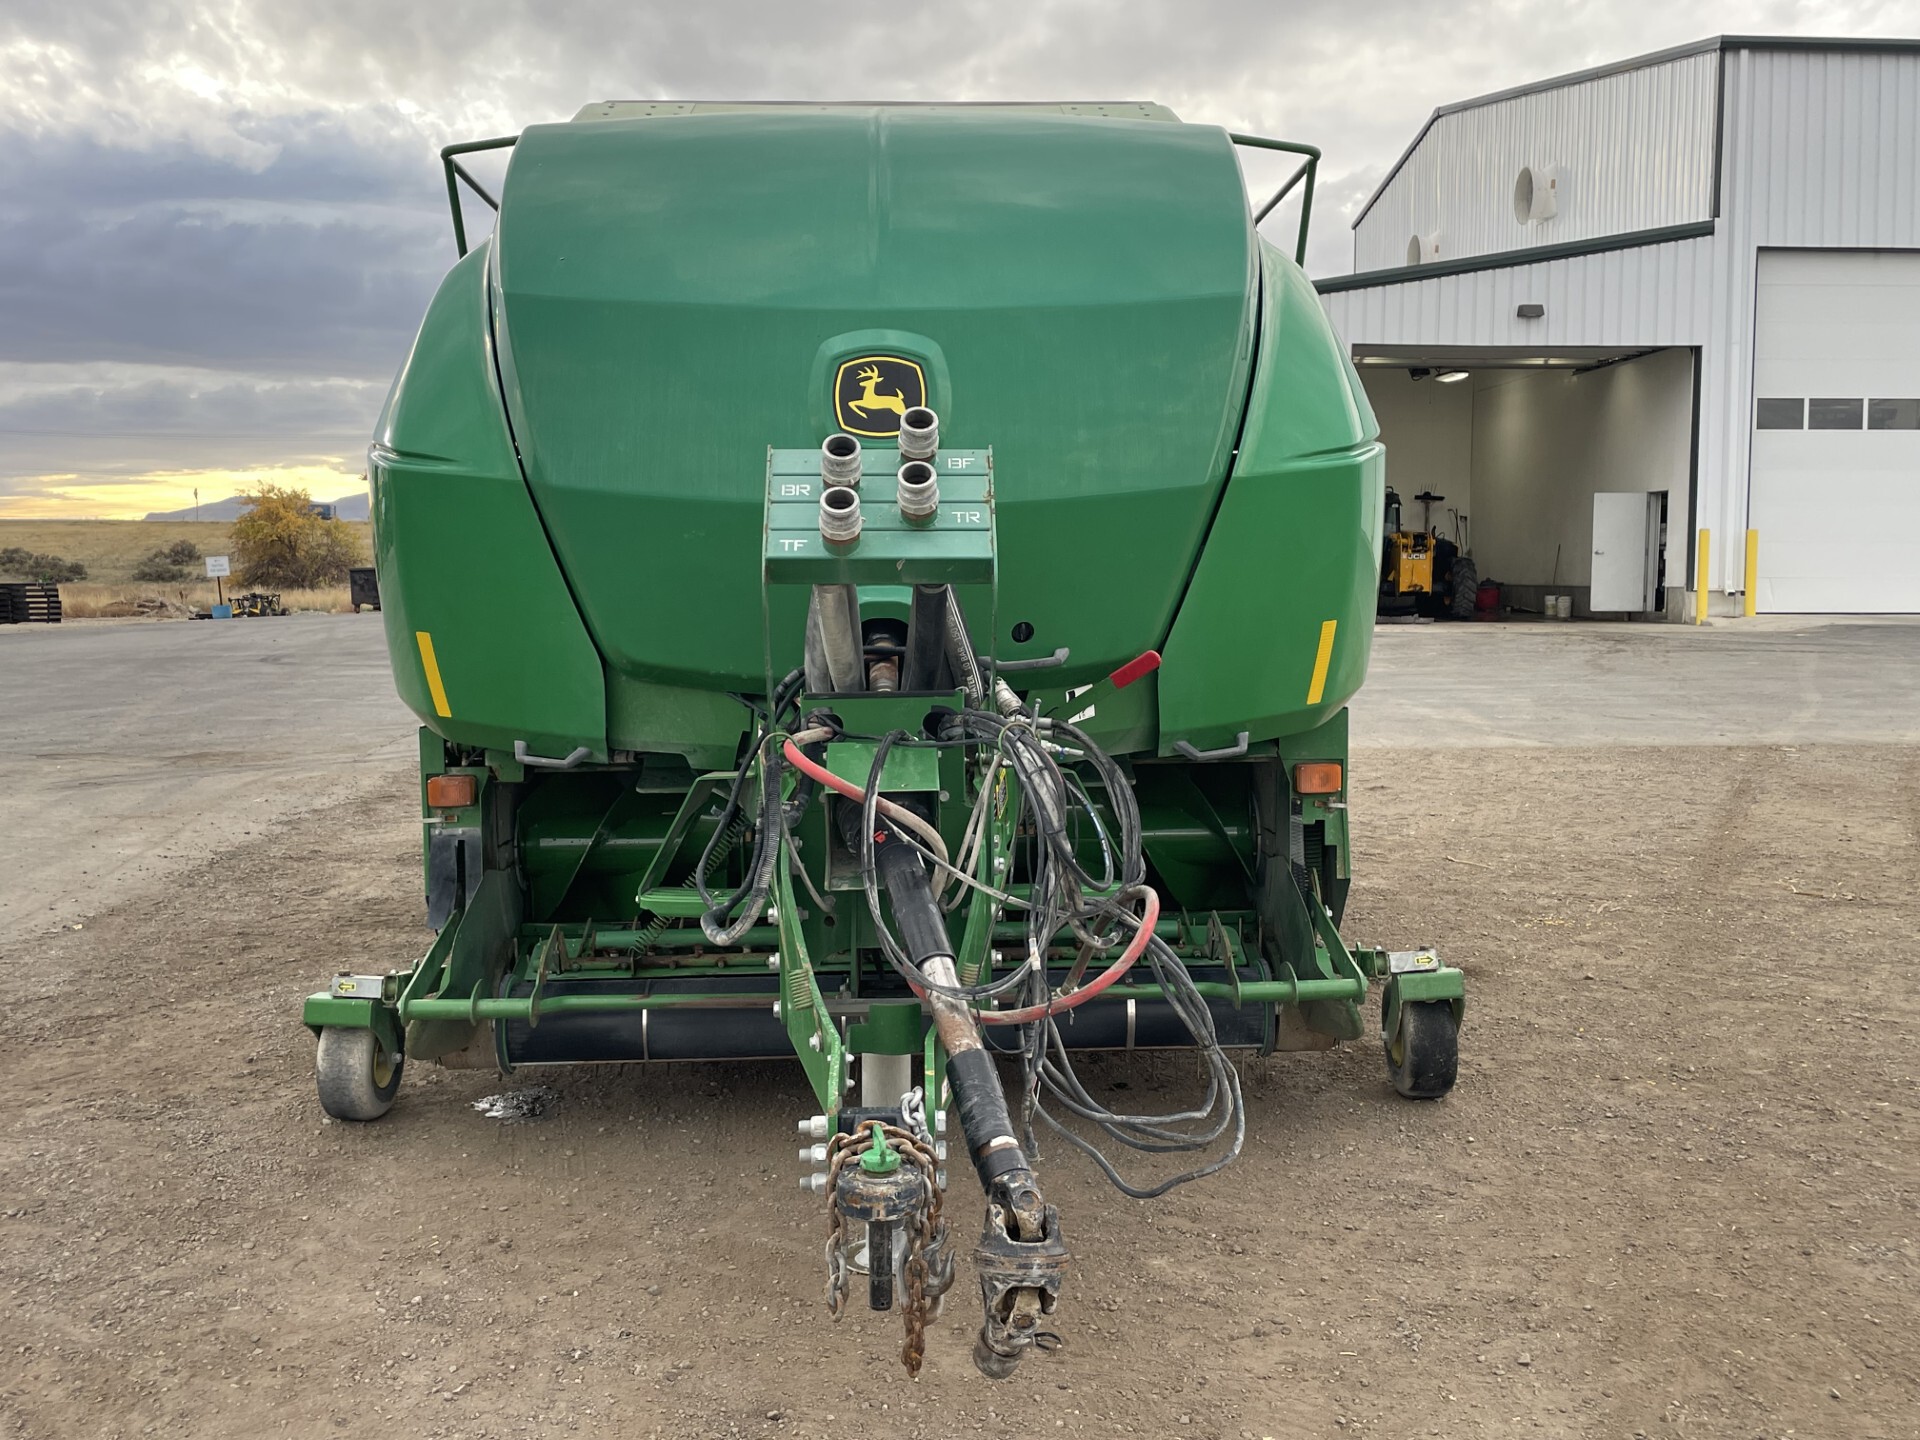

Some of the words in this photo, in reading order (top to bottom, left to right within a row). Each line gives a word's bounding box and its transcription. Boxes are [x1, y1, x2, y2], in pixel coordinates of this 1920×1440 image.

[948, 458, 975, 469] BF
[781, 484, 811, 496] BR
[952, 511, 981, 523] TR
[779, 539, 808, 551] TF
[957, 647, 968, 661] BAR
[966, 674, 978, 698] WATER
